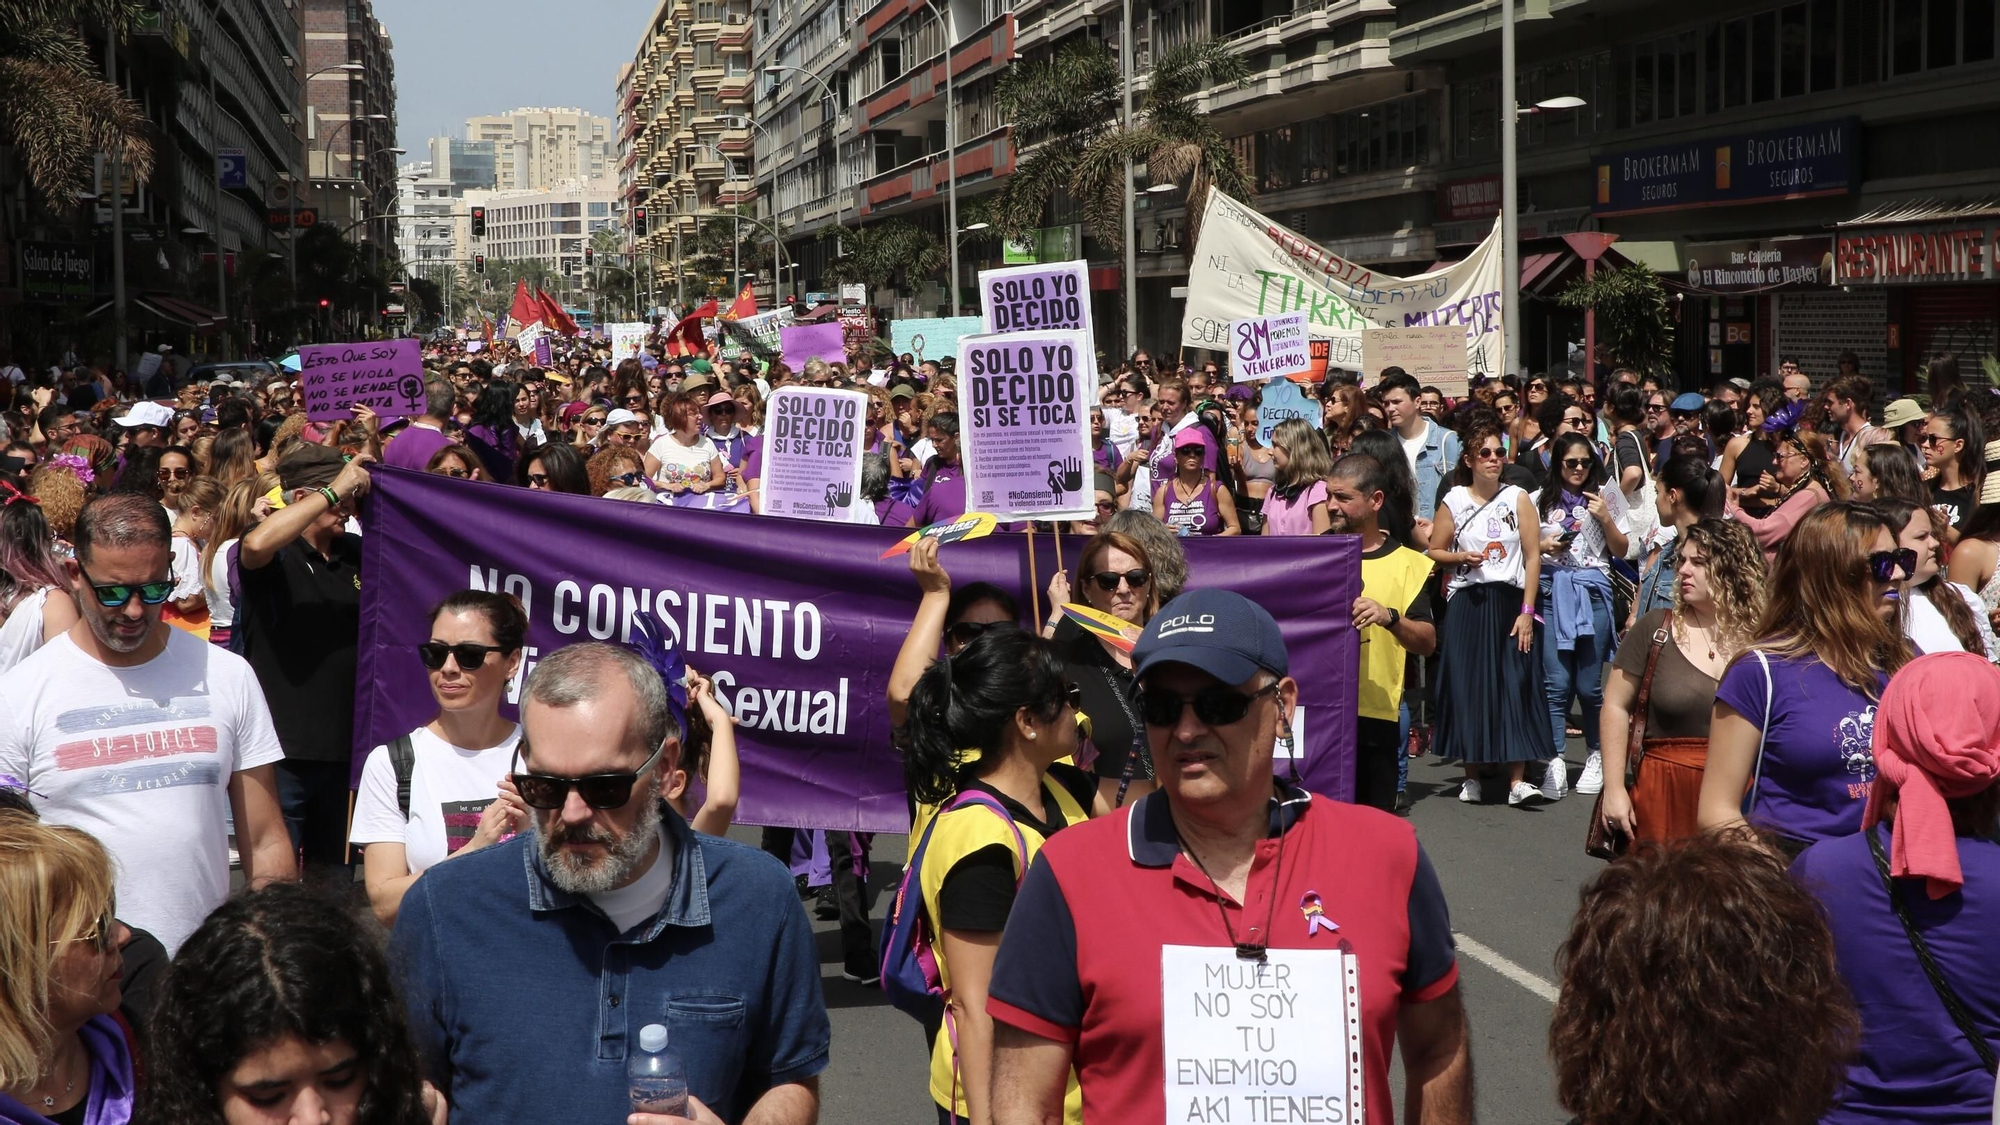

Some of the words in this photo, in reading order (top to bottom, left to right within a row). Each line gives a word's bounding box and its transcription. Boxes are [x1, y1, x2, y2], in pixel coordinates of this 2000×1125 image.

[1747, 127, 1842, 166] BROKERMAM
[219, 158, 234, 179] P
[1624, 148, 1700, 181] BROKERMAM
[1770, 166, 1813, 188] SEGUROS
[1641, 183, 1677, 201] SEGUROS
[23, 249, 49, 270] Salón
[51, 250, 62, 271] de
[64, 252, 89, 279] Juego
[1209, 255, 1229, 271] NI
[1731, 252, 1746, 264] Bar-
[1837, 229, 1985, 278] RESTAURANTE
[1228, 272, 1244, 289] LA
[1703, 270, 1712, 285] El
[1714, 268, 1765, 284] Rinconcito
[1767, 267, 1780, 282] de
[1782, 265, 1818, 284] Hayley
[992, 277, 1045, 304] SOLO
[1051, 274, 1077, 297] YO
[995, 297, 1079, 330] DECIDO
[1356, 306, 1379, 318] NI
[750, 319, 787, 337] KELLYS
[1270, 326, 1300, 341] PODEMOS
[1727, 328, 1749, 342] Bc
[1890, 329, 1896, 345] R
[1237, 319, 1271, 361] 8M
[1276, 341, 1300, 350] JUNTAS
[370, 348, 397, 360] SOY
[970, 347, 1034, 375] SOLO
[1041, 345, 1073, 372] YO
[1242, 354, 1305, 376] VENCEREMOS
[307, 375, 324, 386] NO
[331, 372, 347, 382] SE
[352, 368, 393, 380] VIOLA
[308, 390, 327, 400] NO
[333, 387, 348, 397] SE
[353, 381, 398, 395] VENDE
[972, 372, 1074, 407] DECIDO
[1275, 385, 1292, 405] YO
[310, 403, 330, 413] NO
[333, 400, 351, 410] SE
[778, 396, 826, 417] SOLO
[833, 399, 856, 419] YO
[973, 408, 991, 428] SI
[998, 406, 1020, 427] SE
[1027, 404, 1076, 425] TOCA
[1263, 407, 1299, 420] DECIDO
[776, 416, 855, 442] DECIDO
[774, 438, 788, 453] SI
[793, 440, 811, 455] SE
[816, 441, 852, 458] TOCA
[1009, 490, 1051, 499] #NoConsiento
[793, 502, 826, 510] #NoConsiento
[469, 563, 533, 621] NO
[553, 579, 822, 661] CONSIENTO
[1160, 614, 1214, 632] POLO
[96, 701, 143, 726] CUSTOM
[715, 671, 849, 736] Sexual
[92, 727, 199, 758] SP-FORCE
[101, 769, 127, 788] THE
[136, 760, 197, 790] ACADEMY
[1849, 790, 1861, 799] SE
[1205, 963, 1291, 990] MUJER
[1194, 992, 1230, 1018] NO
[1251, 992, 1298, 1019] SOY
[1236, 1026, 1275, 1052] TU
[1177, 1059, 1297, 1086] ENEMIGO
[1187, 1096, 1230, 1124] AKI
[1245, 1090, 1343, 1124] TIENES
